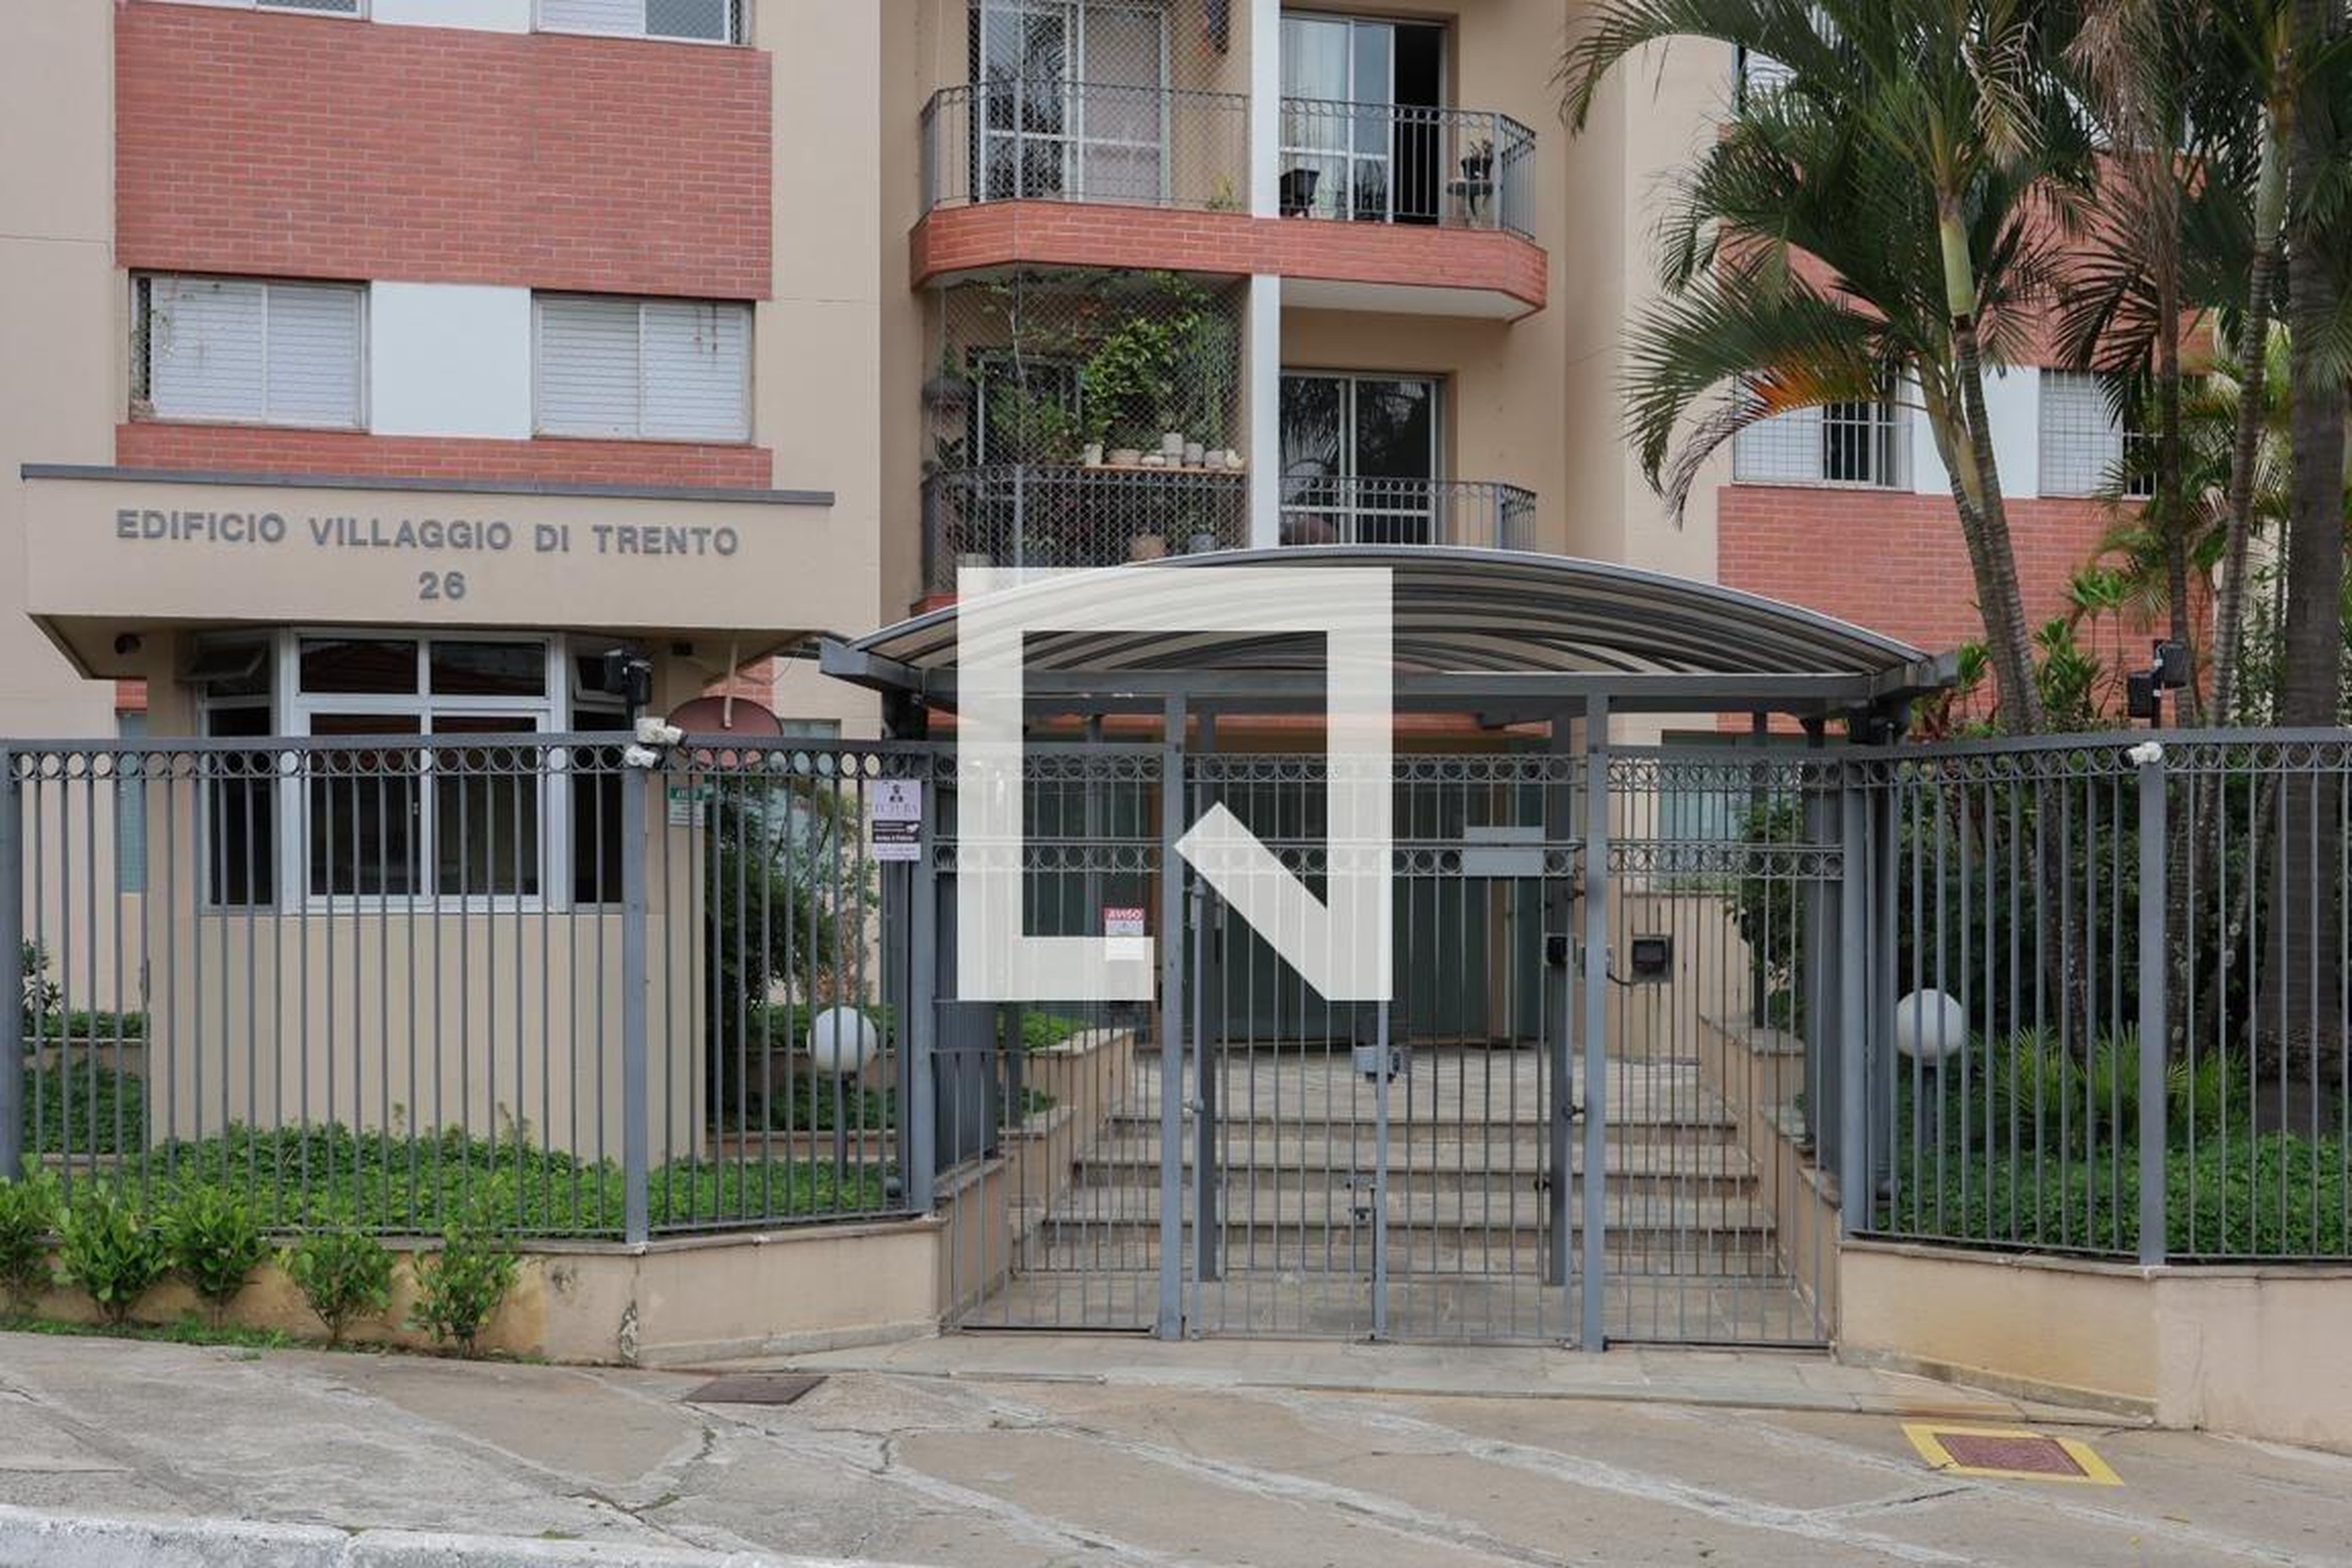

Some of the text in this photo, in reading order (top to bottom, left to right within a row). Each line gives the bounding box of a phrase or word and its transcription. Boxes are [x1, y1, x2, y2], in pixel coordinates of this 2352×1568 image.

[116, 510, 738, 557] EDIFICIO VILLAGGIO DI TRENTO
[418, 571, 466, 601] 26
[1108, 908, 1143, 919] AVISO
